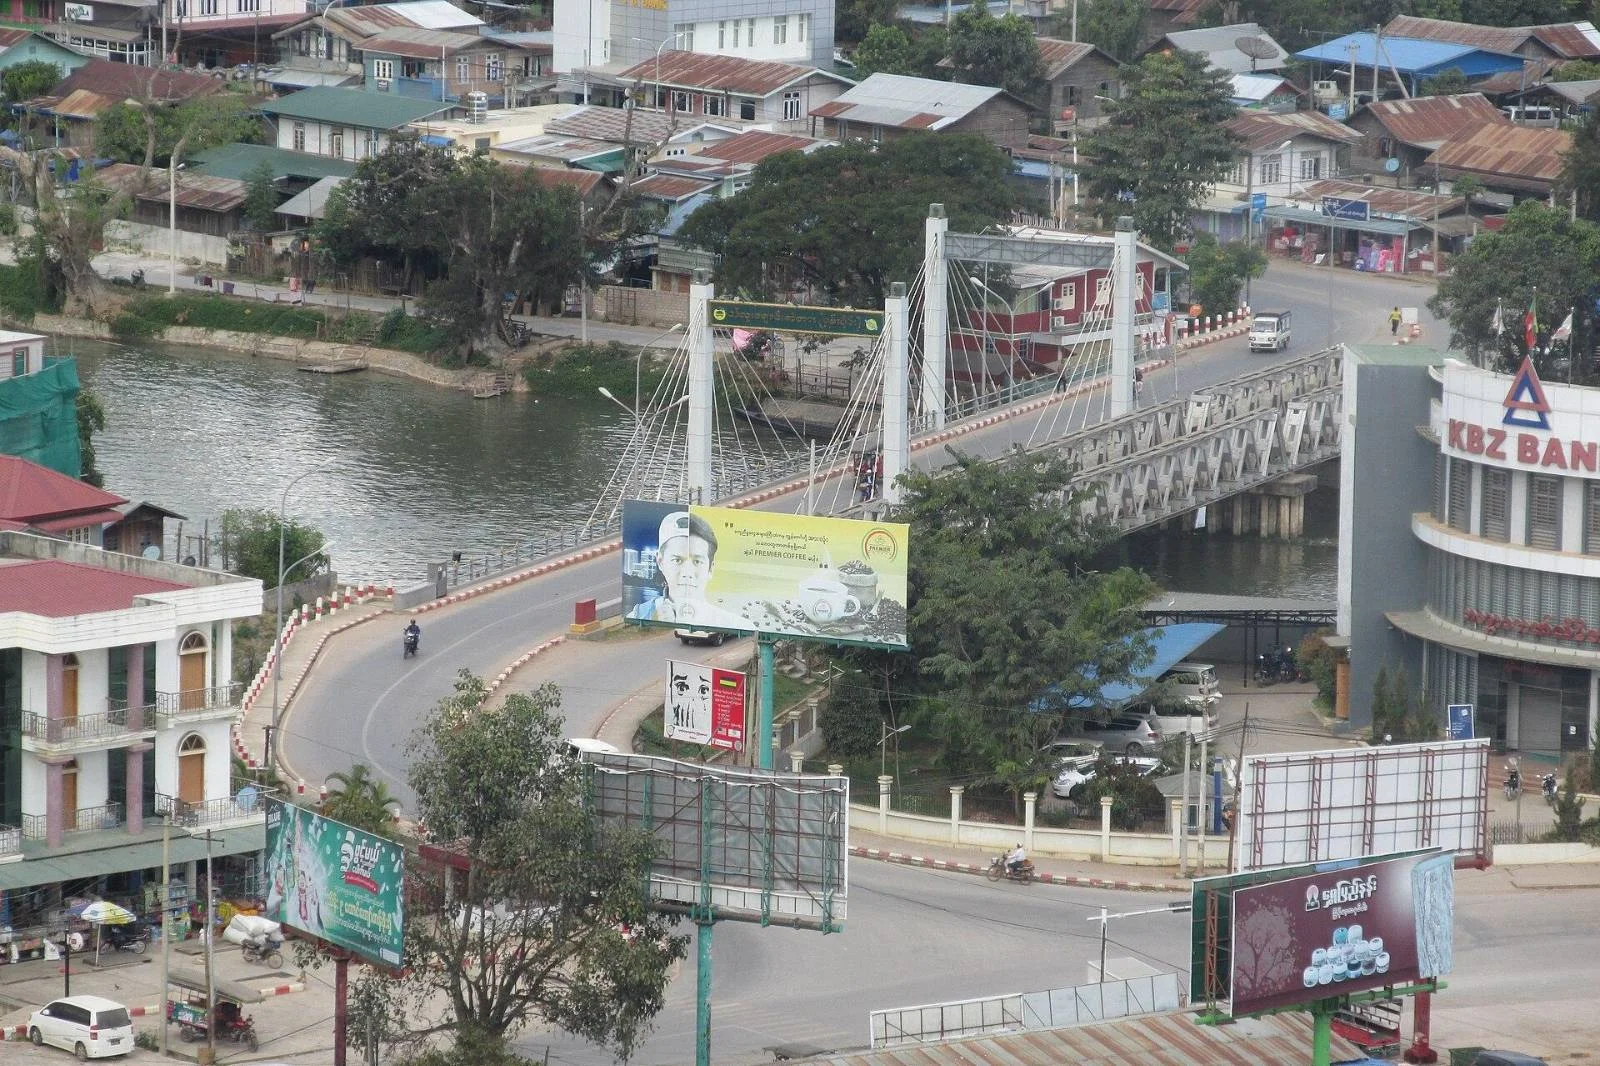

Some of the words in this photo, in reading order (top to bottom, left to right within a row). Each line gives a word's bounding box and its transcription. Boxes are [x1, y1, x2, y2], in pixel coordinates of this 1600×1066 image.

[1448, 418, 1507, 461] KBZ
[1517, 433, 1600, 473] BAN
[754, 549, 782, 558] PREMIER
[783, 551, 807, 560] COFFEE
